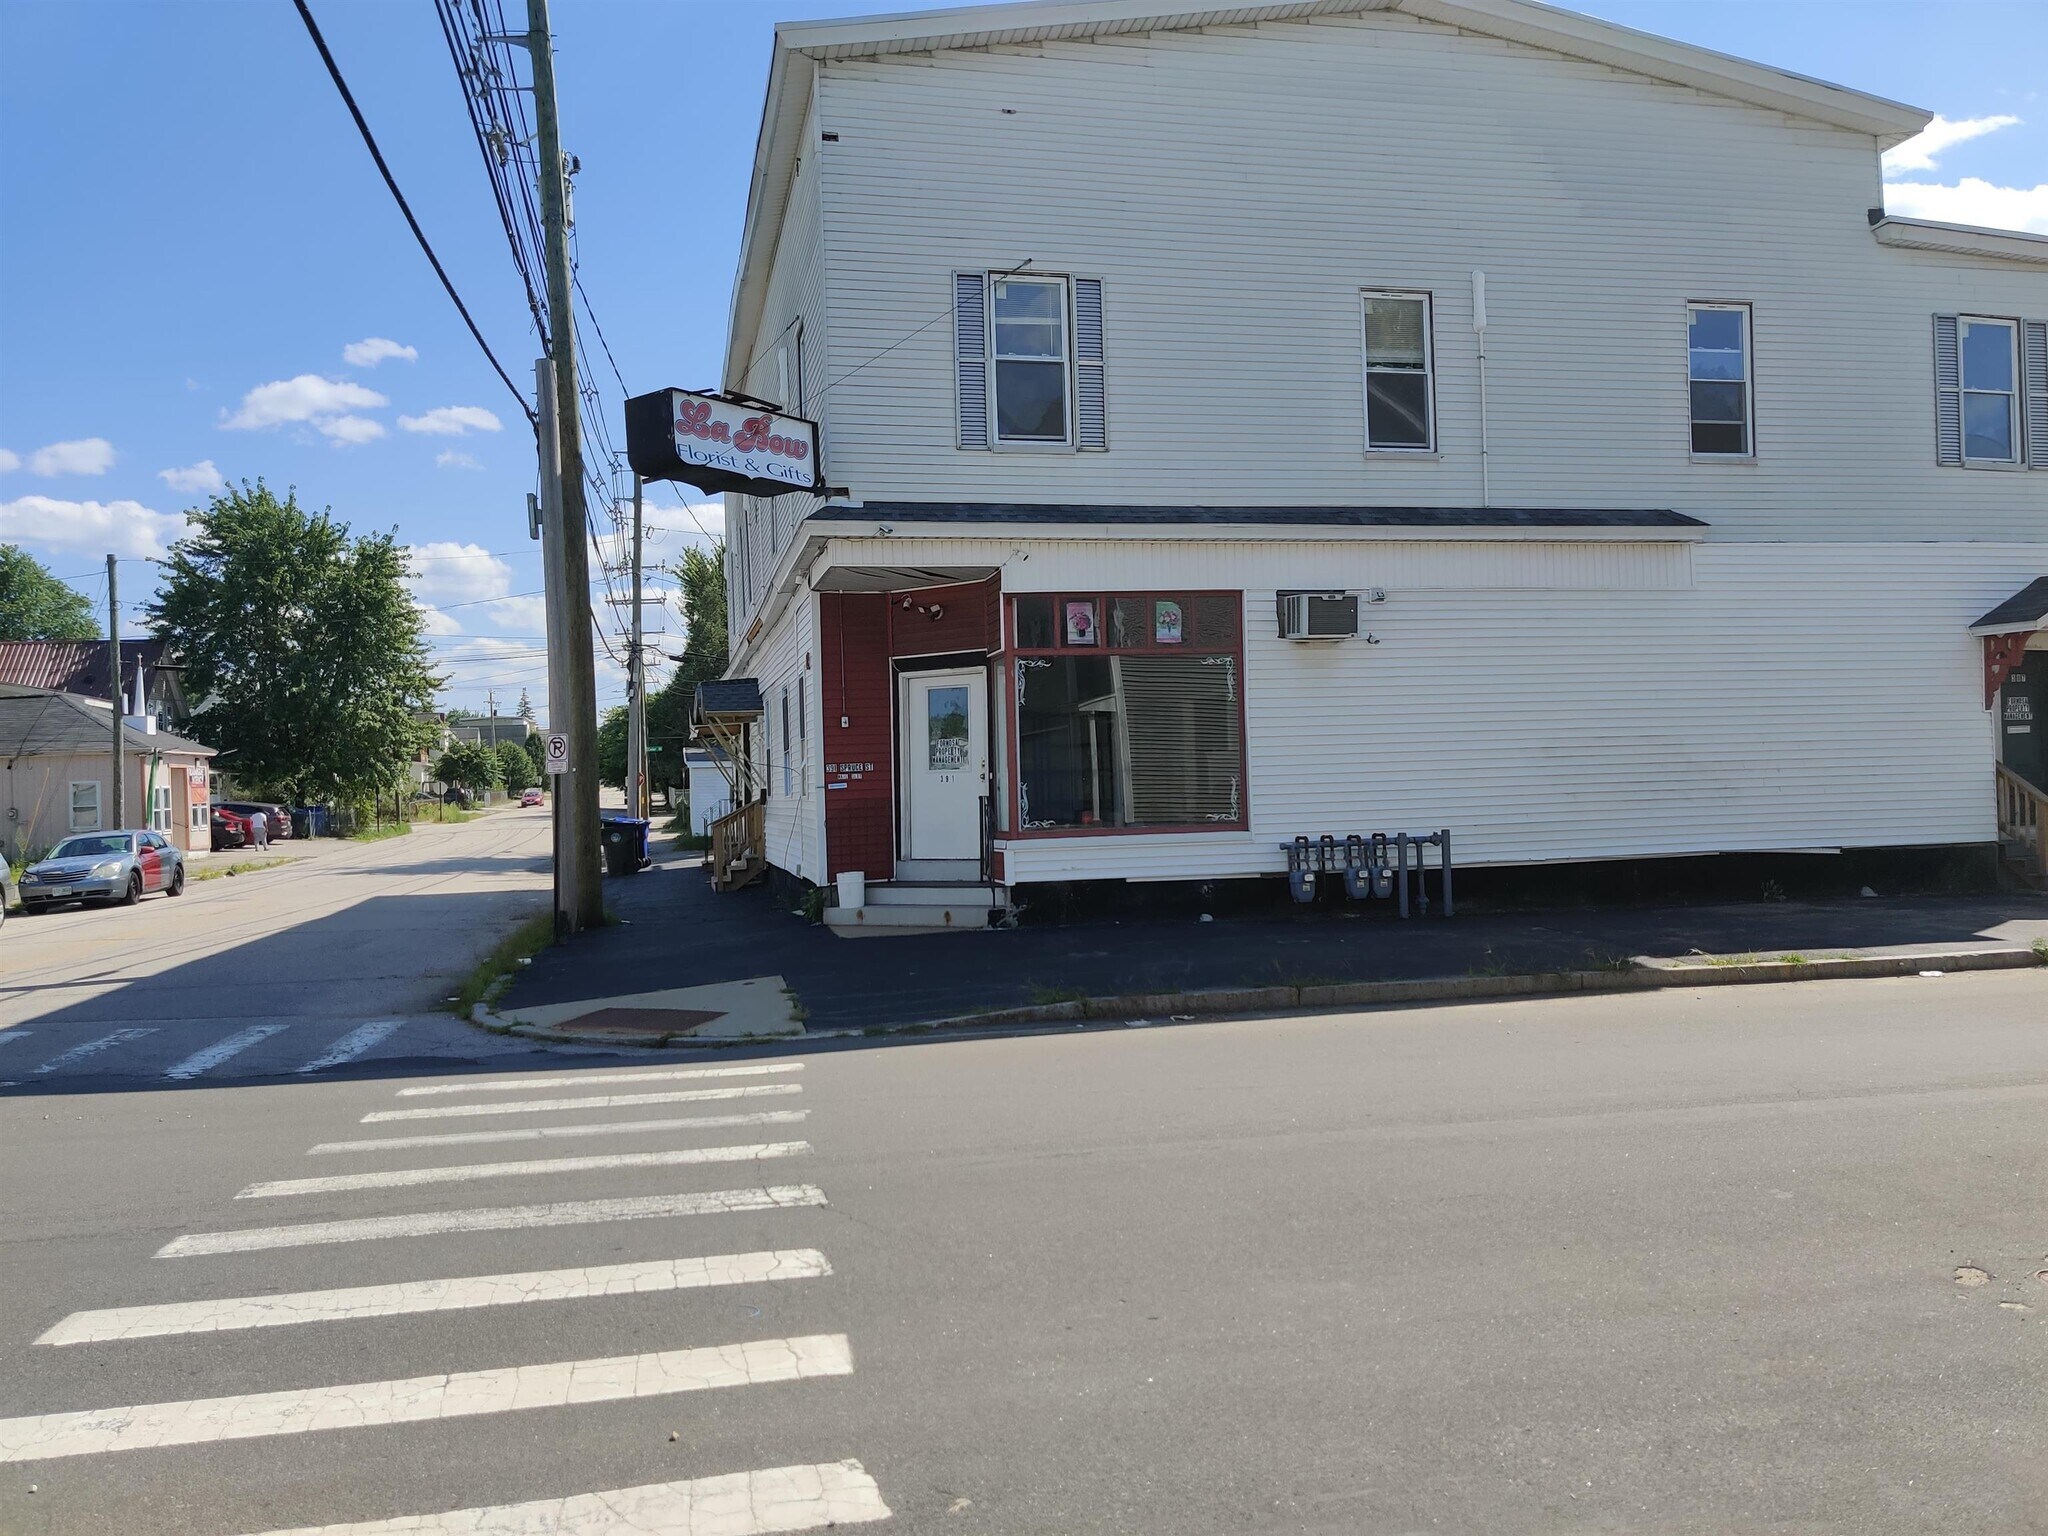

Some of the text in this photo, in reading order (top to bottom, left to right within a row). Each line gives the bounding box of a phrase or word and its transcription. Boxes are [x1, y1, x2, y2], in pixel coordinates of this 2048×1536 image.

[676, 443, 811, 484] Florist & Gifts
[935, 747, 961, 755] PROPERTY
[932, 756, 964, 764] MANAGEMENT
[840, 763, 863, 772] SPRUCE
